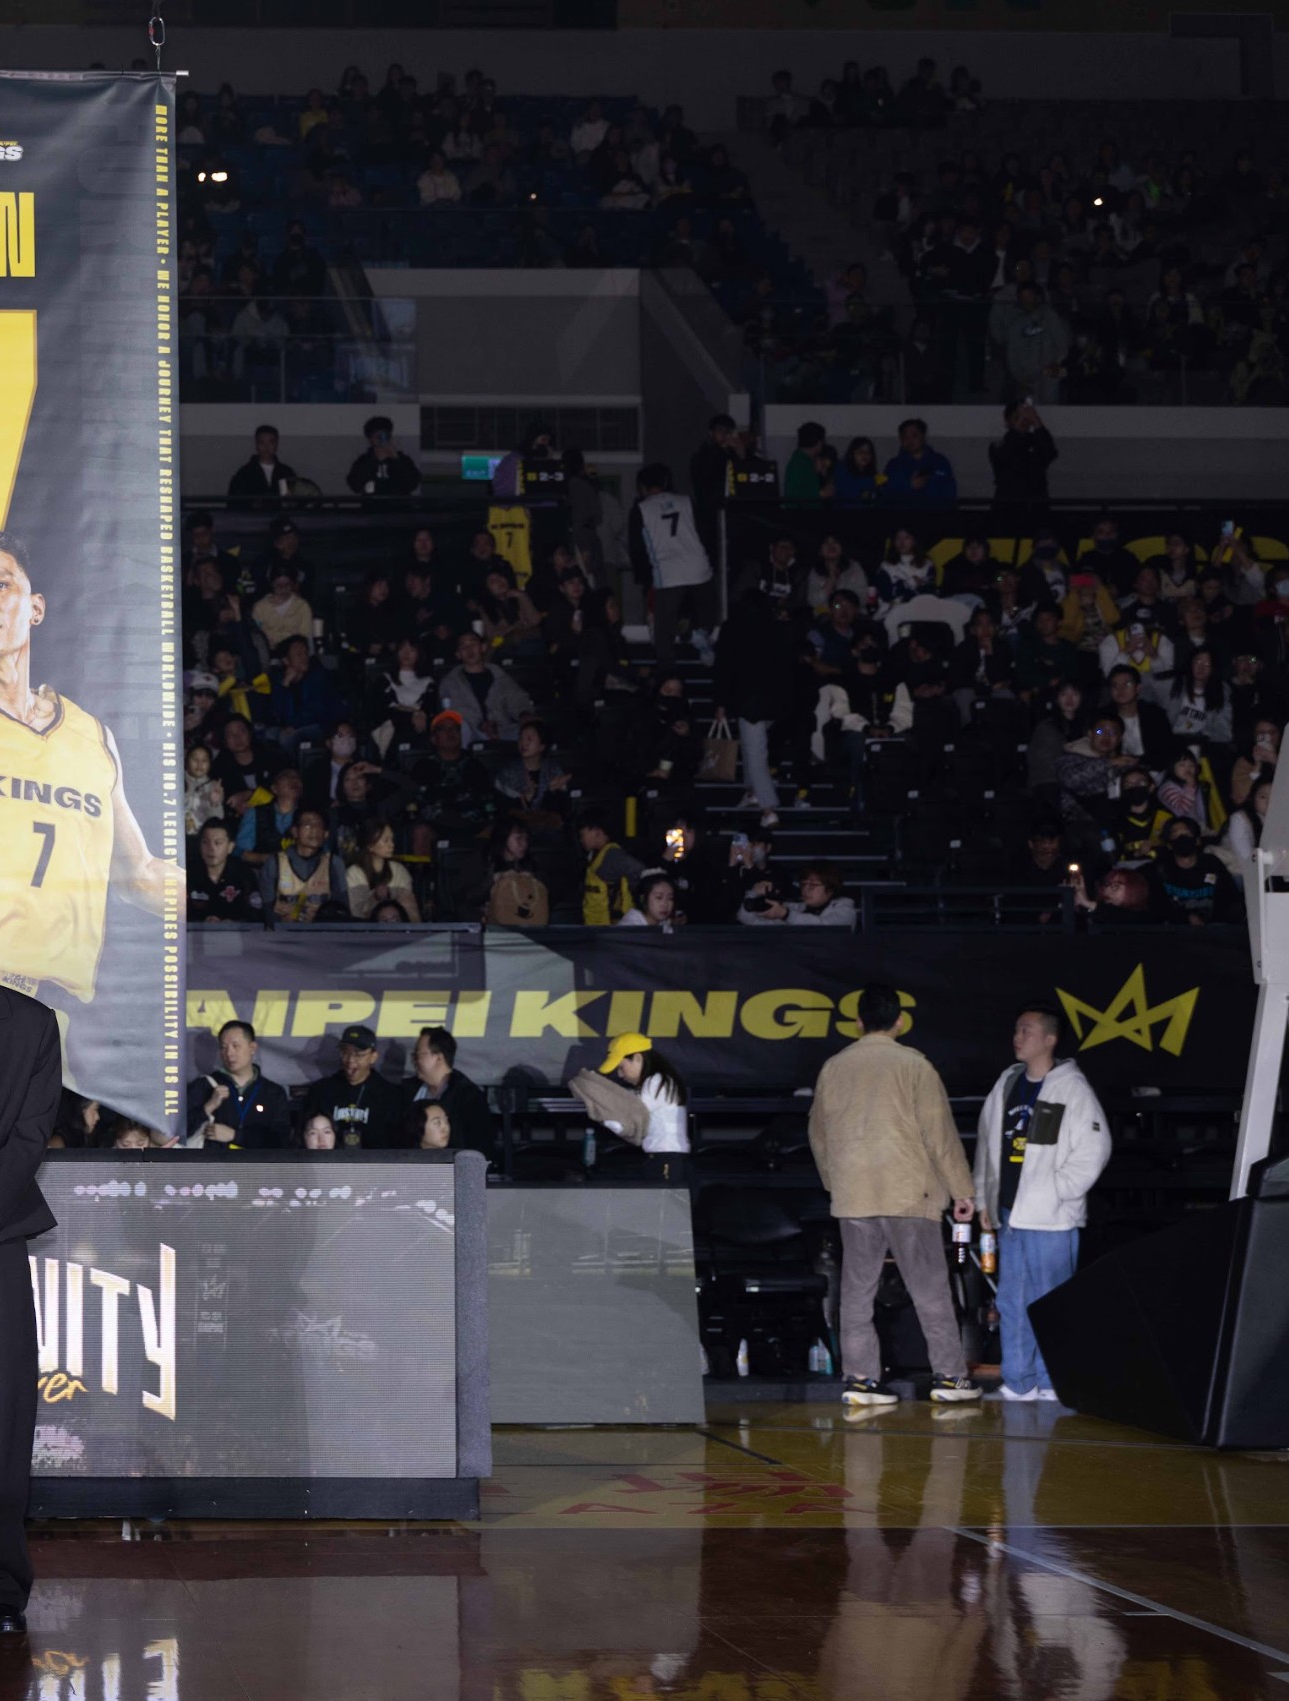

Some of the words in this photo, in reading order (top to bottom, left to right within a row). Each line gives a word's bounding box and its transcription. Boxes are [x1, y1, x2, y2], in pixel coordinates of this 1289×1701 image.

[155, 104, 169, 142] MORE
[156, 148, 169, 182] THAN
[156, 188, 169, 197] A
[156, 202, 170, 255] PLAYER
[157, 270, 170, 289] WE
[157, 294, 171, 340] HONOR
[158, 346, 171, 354] A
[158, 360, 172, 423] JOURNEY
[158, 430, 172, 463] THAT
[159, 468, 173, 540] RESHAPED
[661, 511, 681, 537] 7
[160, 546, 175, 636] BASKETBALL
[161, 642, 177, 727] WORLDWIDE
[161, 742, 177, 767] HIS
[162, 772, 177, 806] NO.7
[30, 821, 55, 888] 7
[162, 812, 178, 866] LEGACY
[162, 872, 178, 940] INSPIRES
[163, 946, 179, 1039] POSSIBILITY
[186, 990, 492, 1038] AIPEI
[510, 988, 918, 1040] KINGS
[164, 1044, 179, 1060] IN
[164, 1066, 179, 1084] US
[164, 1090, 179, 1116] ALL
